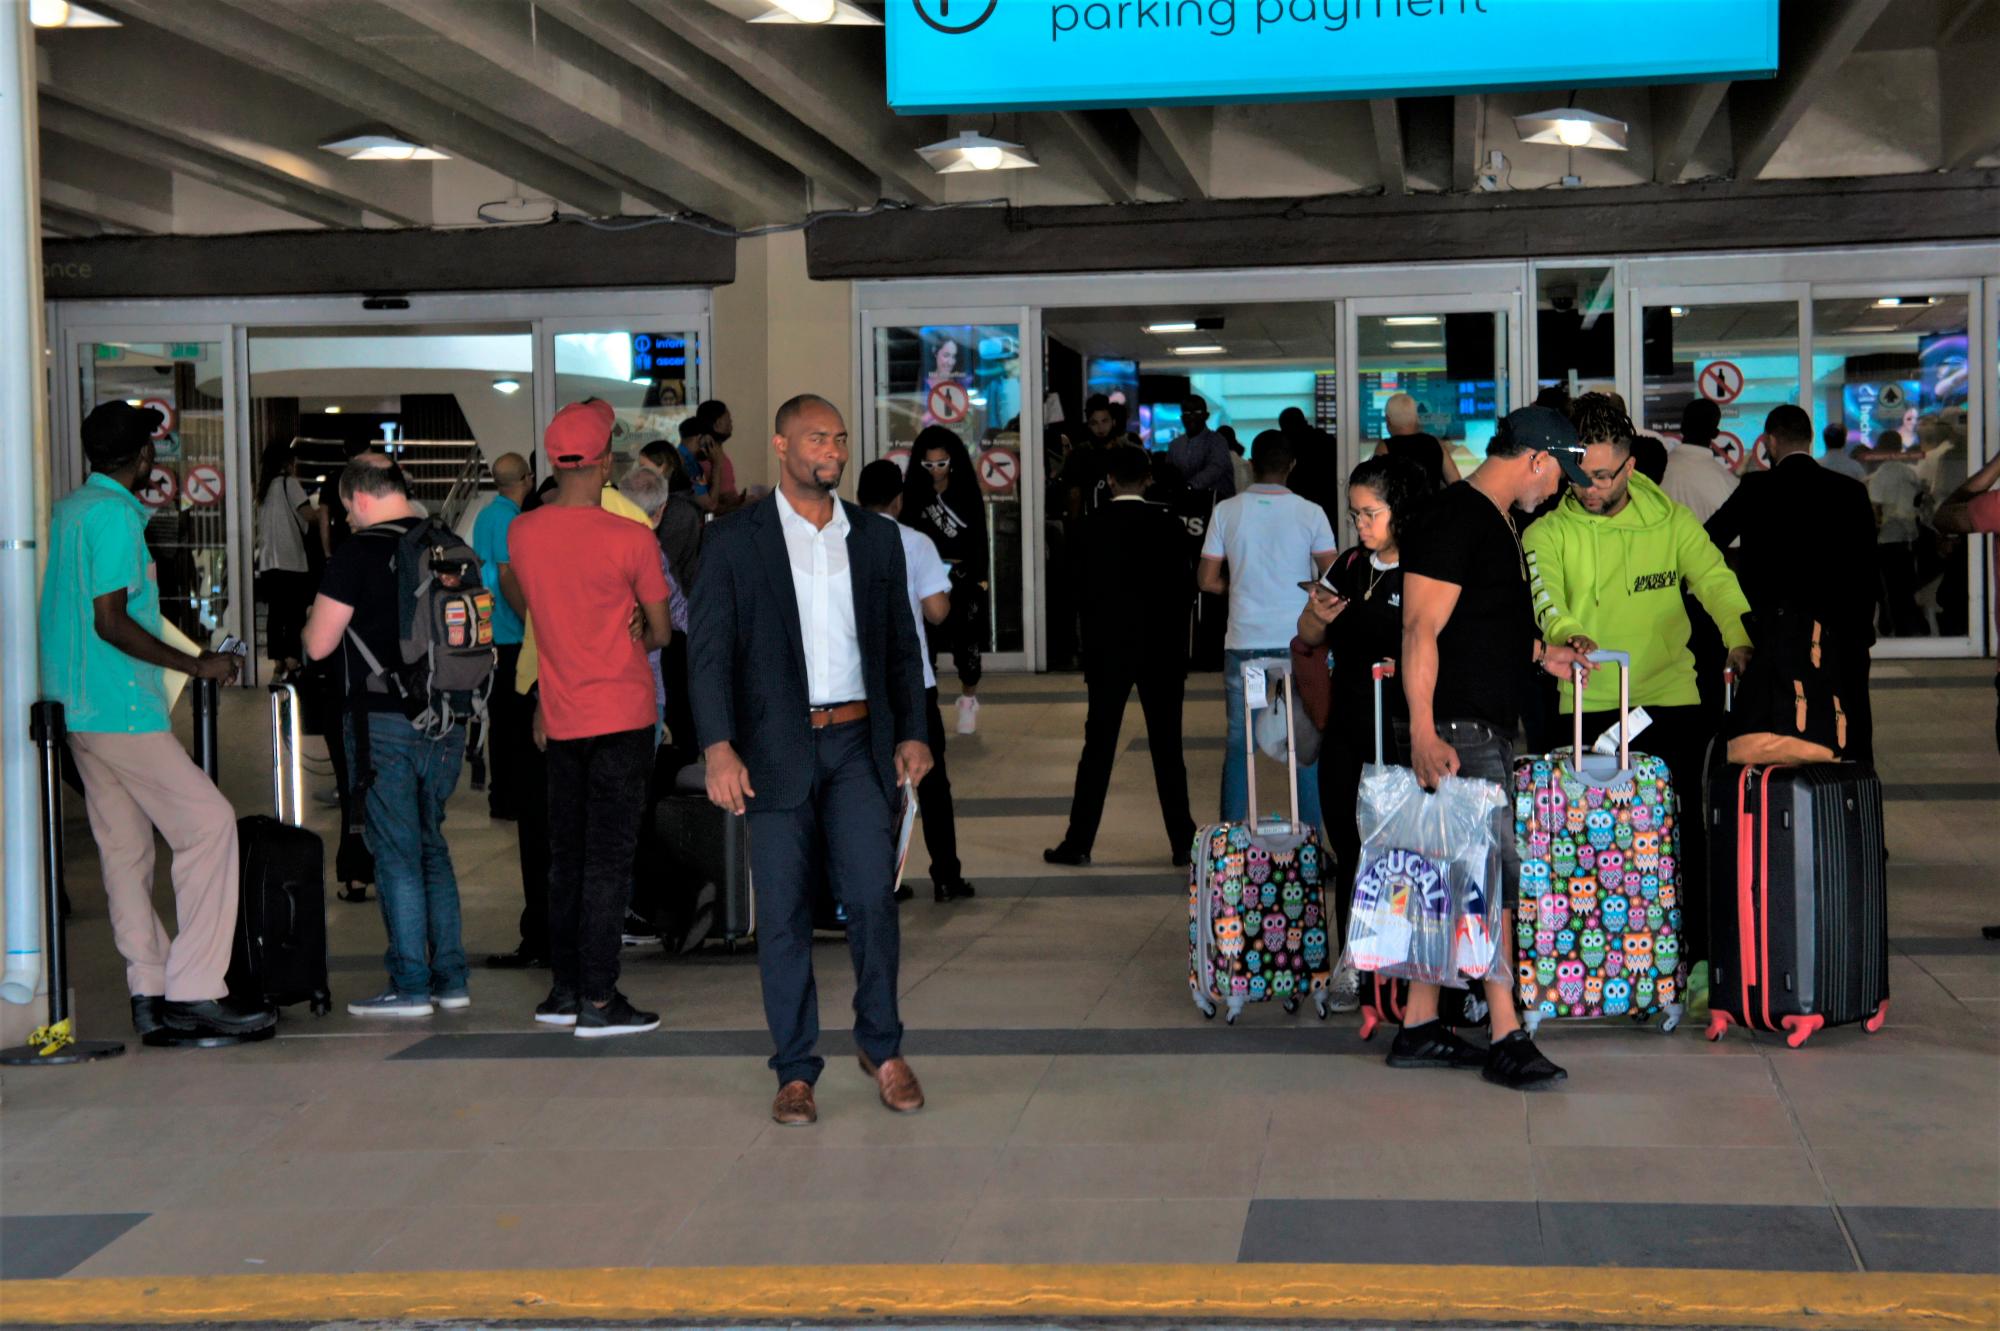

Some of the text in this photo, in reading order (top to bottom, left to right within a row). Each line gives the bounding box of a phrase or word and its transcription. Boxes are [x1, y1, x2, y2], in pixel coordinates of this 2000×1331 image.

[1052, 0, 1235, 42] parking
[1634, 570, 1676, 585] AMERICAN
[1634, 578, 1676, 592] EAGLE
